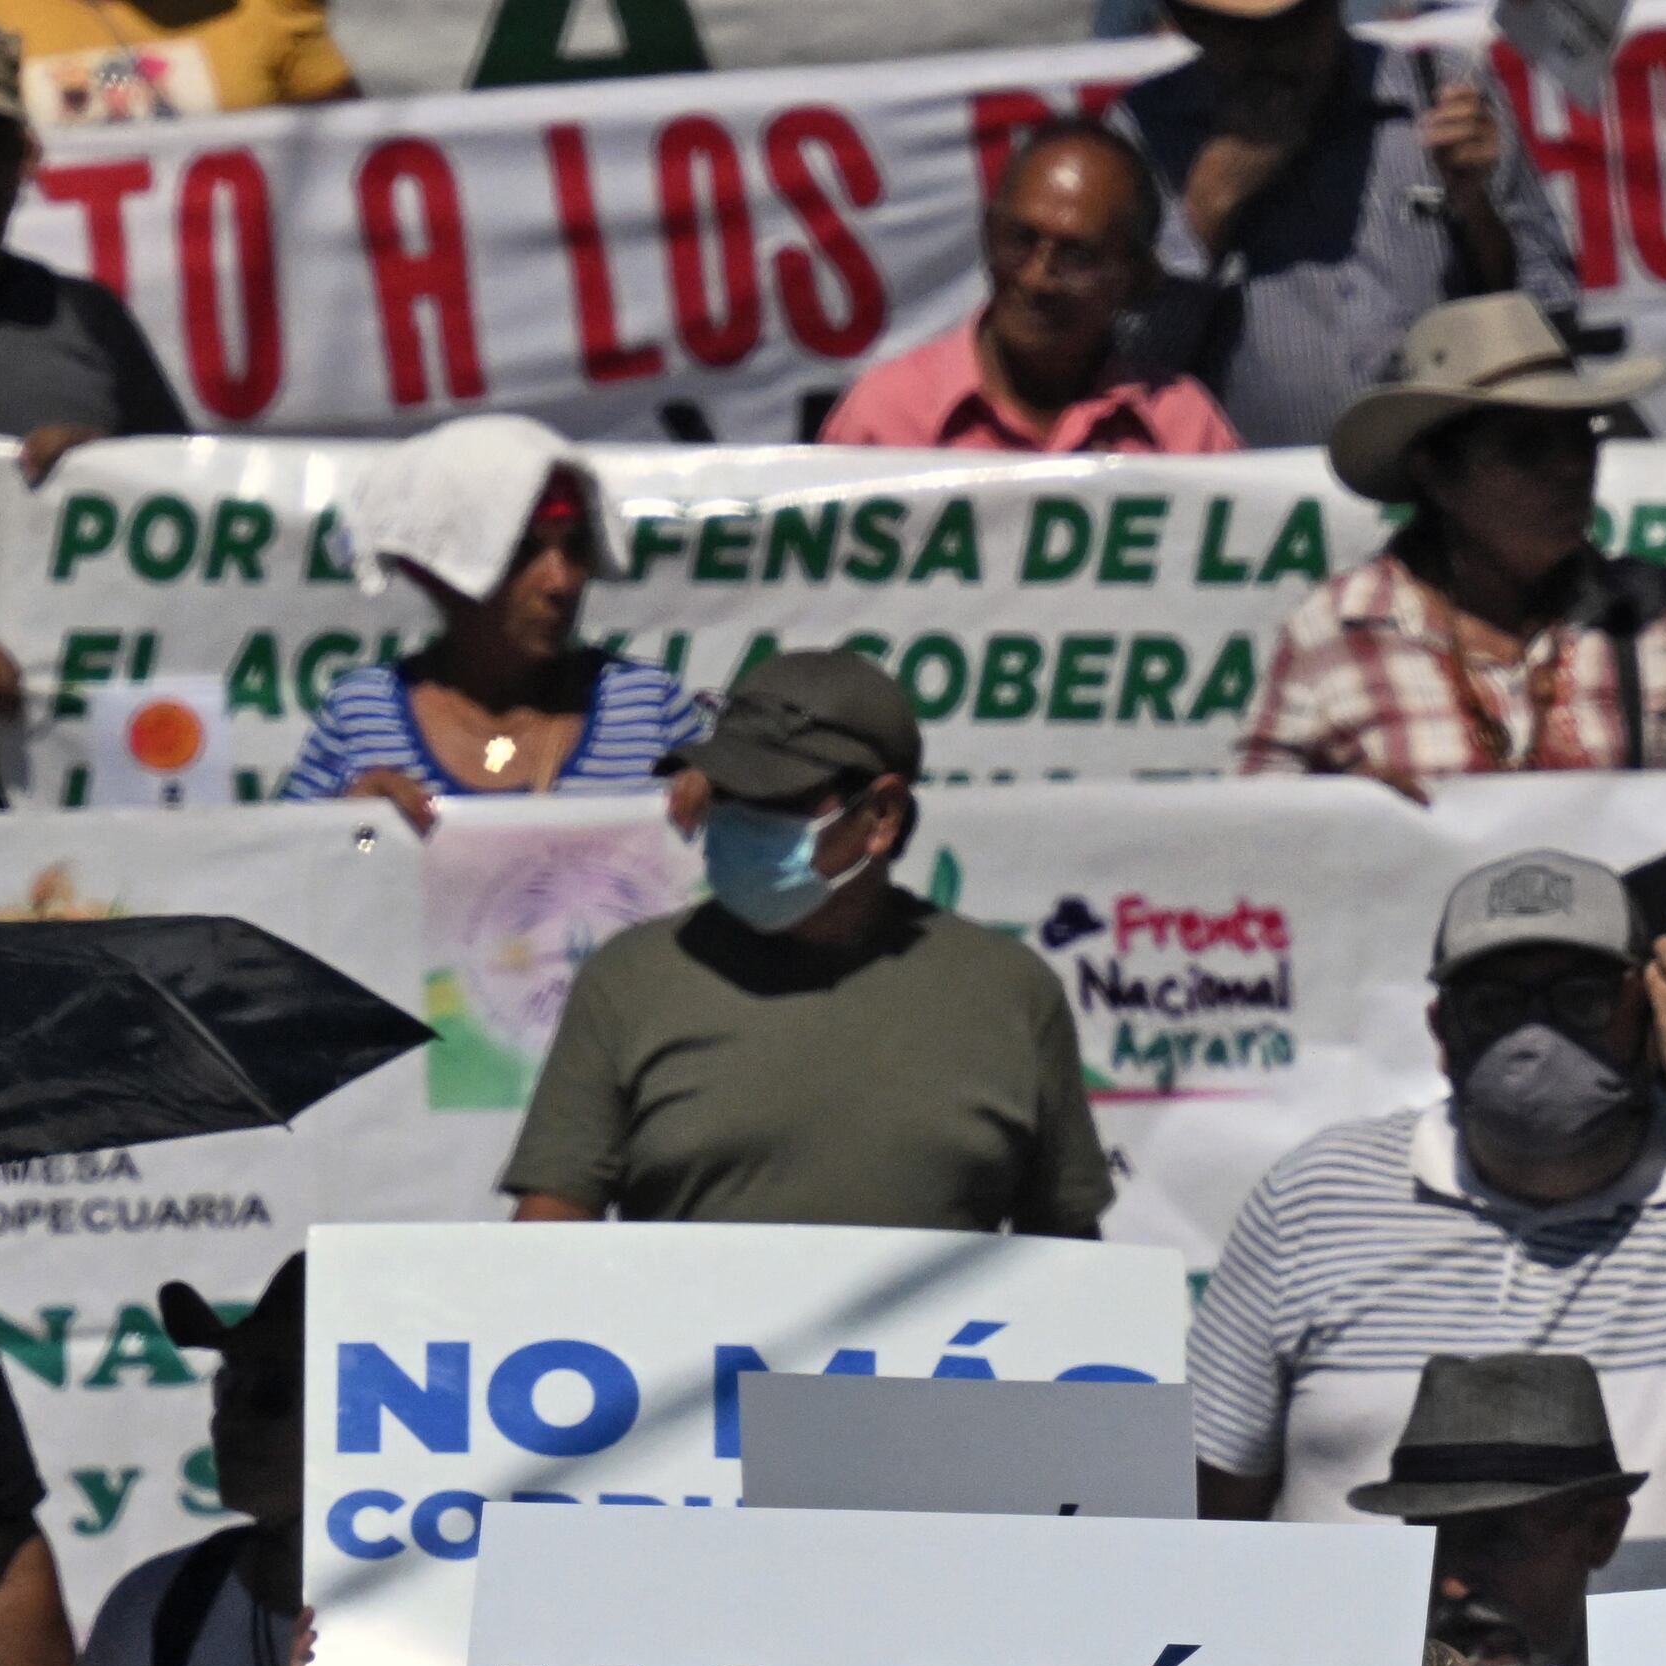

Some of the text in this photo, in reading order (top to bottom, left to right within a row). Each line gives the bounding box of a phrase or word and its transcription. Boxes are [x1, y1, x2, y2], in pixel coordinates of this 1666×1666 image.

[355, 135, 487, 408] A
[545, 102, 887, 385] LOS
[50, 493, 278, 584] POR
[1021, 496, 1167, 584] DE
[1196, 496, 1331, 584] LA
[1114, 895, 1290, 954] Frente
[336, 1339, 641, 1458] NO
